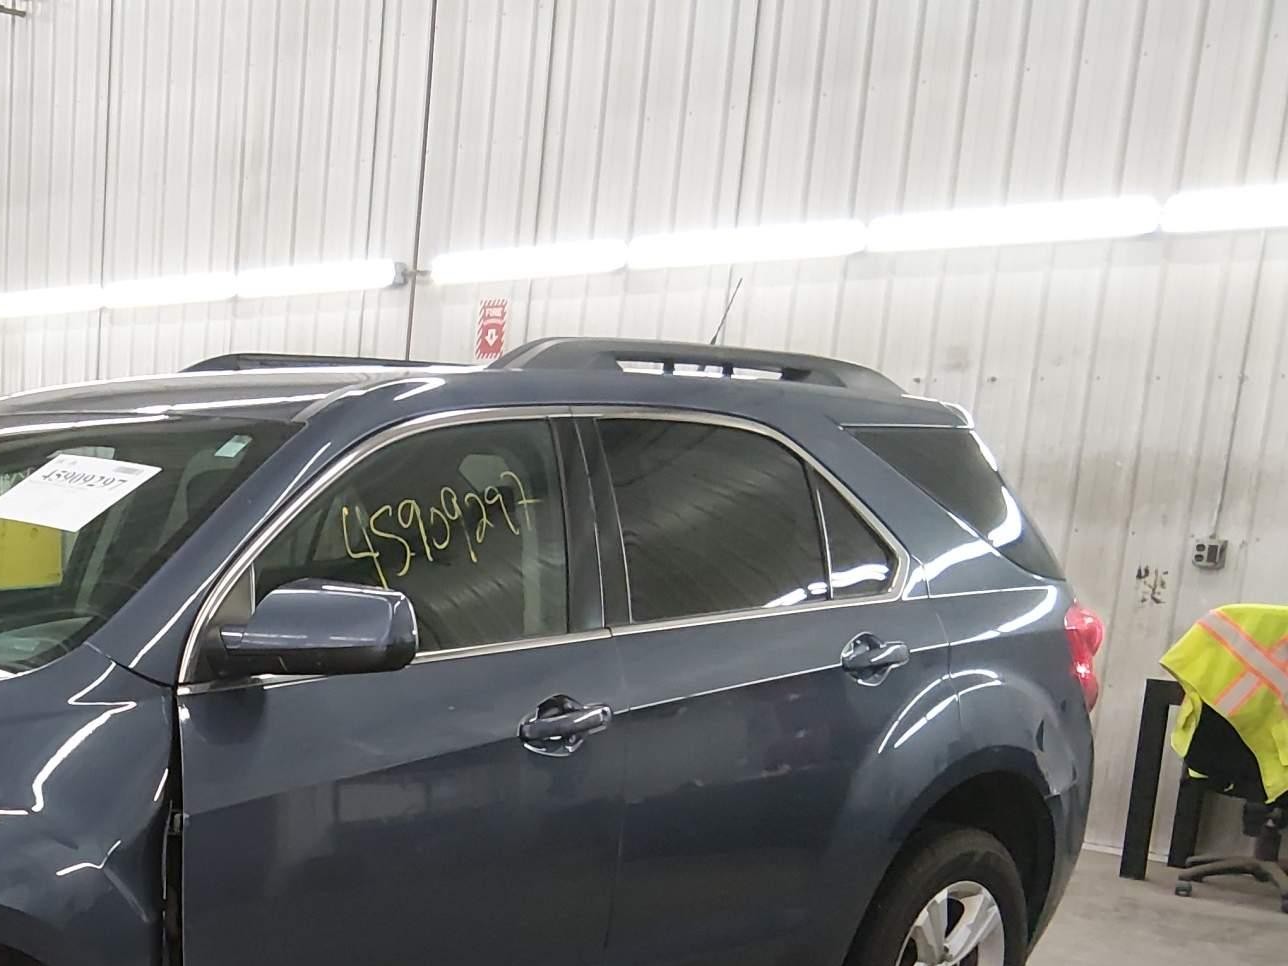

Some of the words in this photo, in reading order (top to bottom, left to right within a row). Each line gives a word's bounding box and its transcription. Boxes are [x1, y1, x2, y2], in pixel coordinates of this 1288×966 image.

[485, 307, 504, 317] FIRE
[41, 468, 129, 492] 45909297
[342, 471, 542, 590] 45909297
